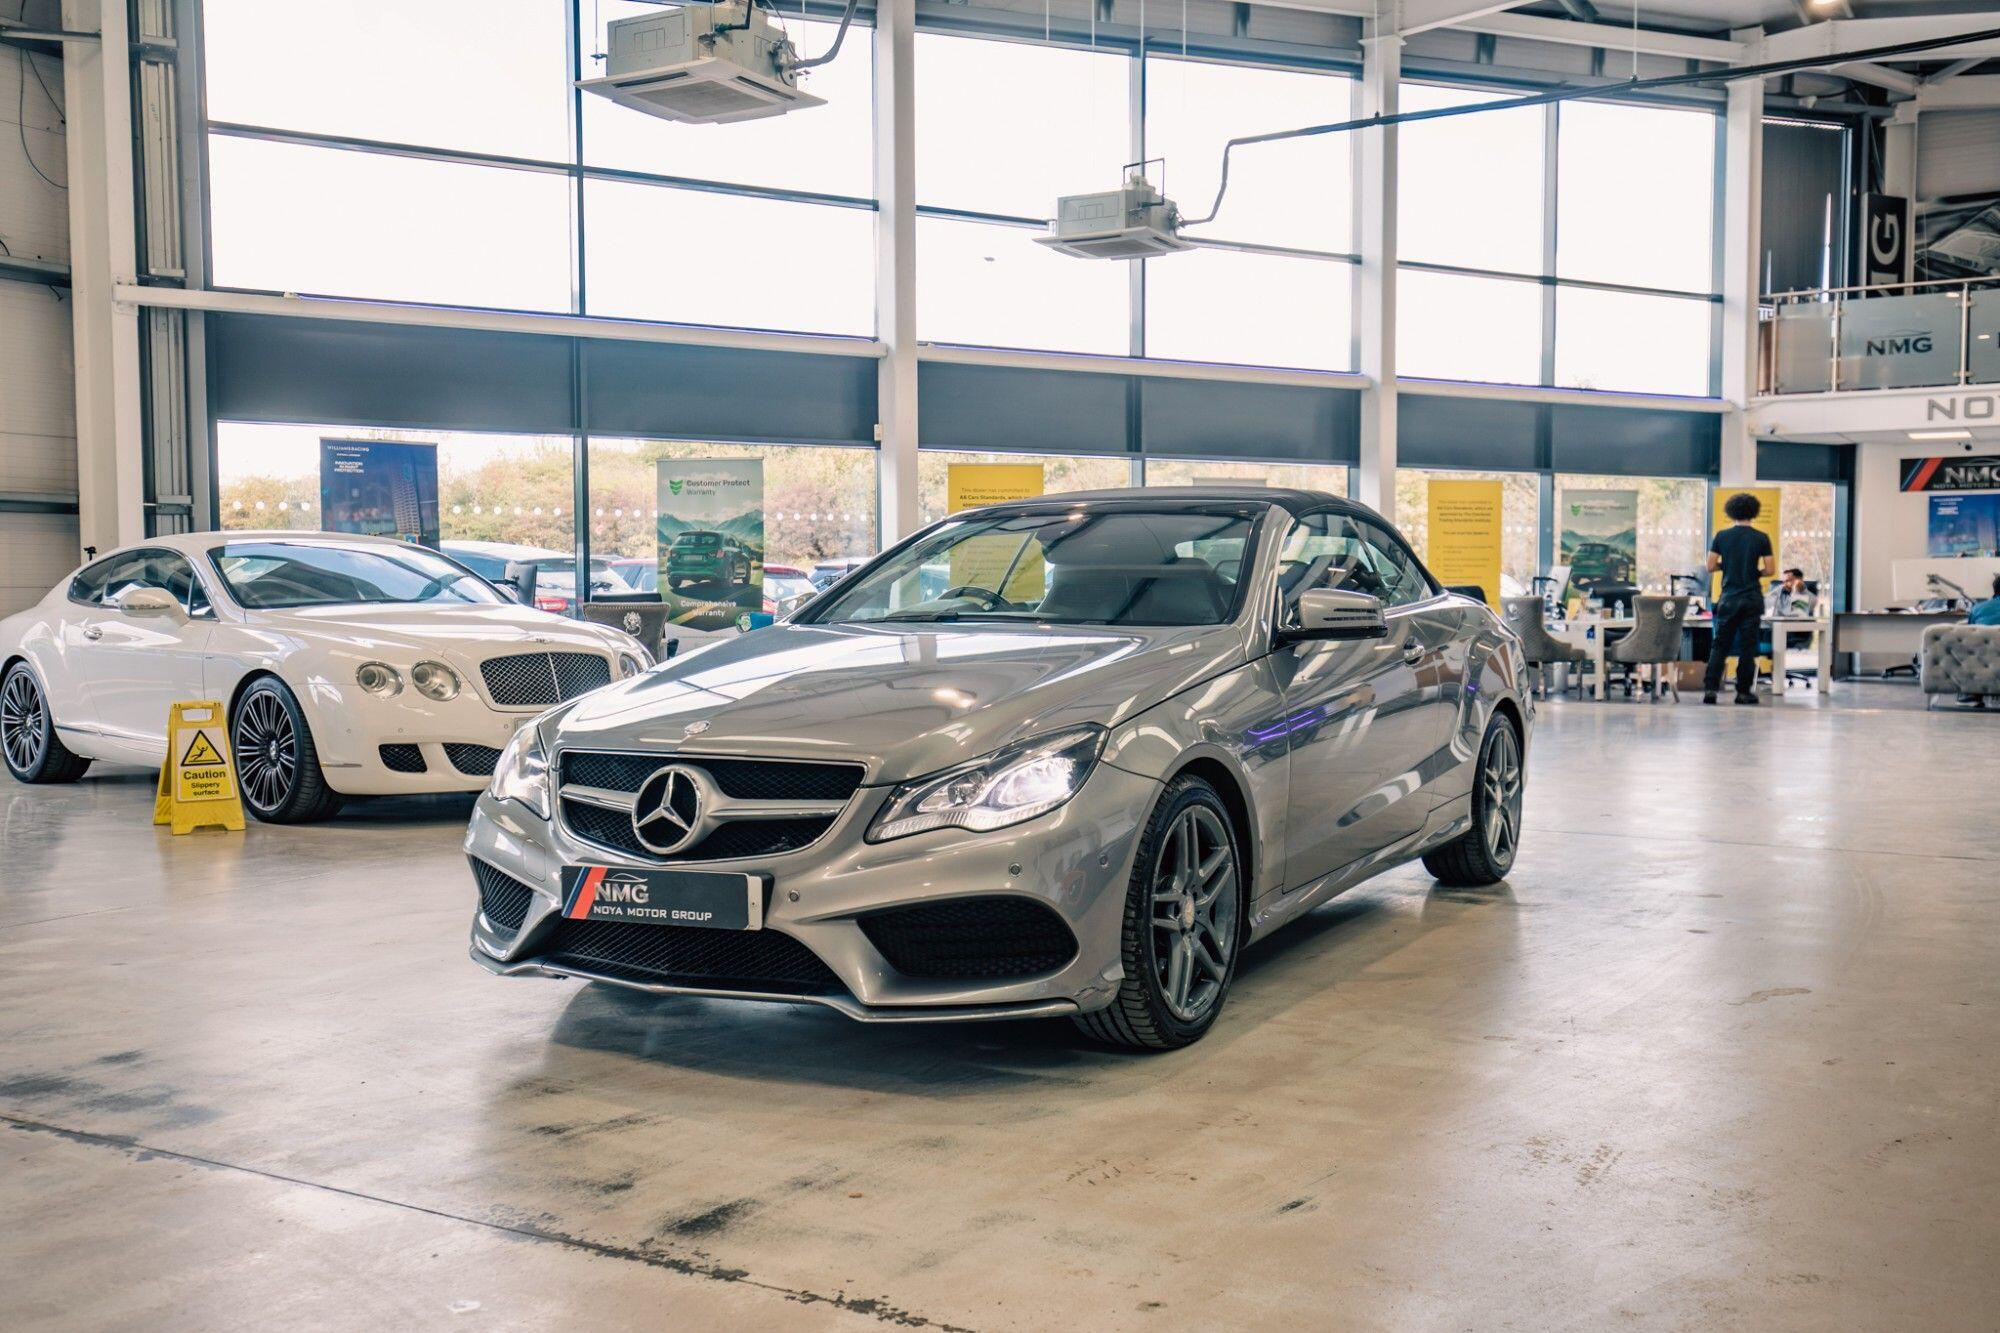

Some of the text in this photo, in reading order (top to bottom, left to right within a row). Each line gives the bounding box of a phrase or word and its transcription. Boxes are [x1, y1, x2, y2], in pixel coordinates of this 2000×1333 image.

[1866, 337, 1933, 357] NMG
[1926, 396, 2000, 421] NO
[723, 479, 750, 487] Protect
[680, 600, 737, 609] Comprehensive
[183, 770, 226, 780] Caution
[191, 781, 220, 789] Slippery
[594, 882, 649, 904] NMG
[593, 905, 713, 921] NOYA MOTOR GROUP
